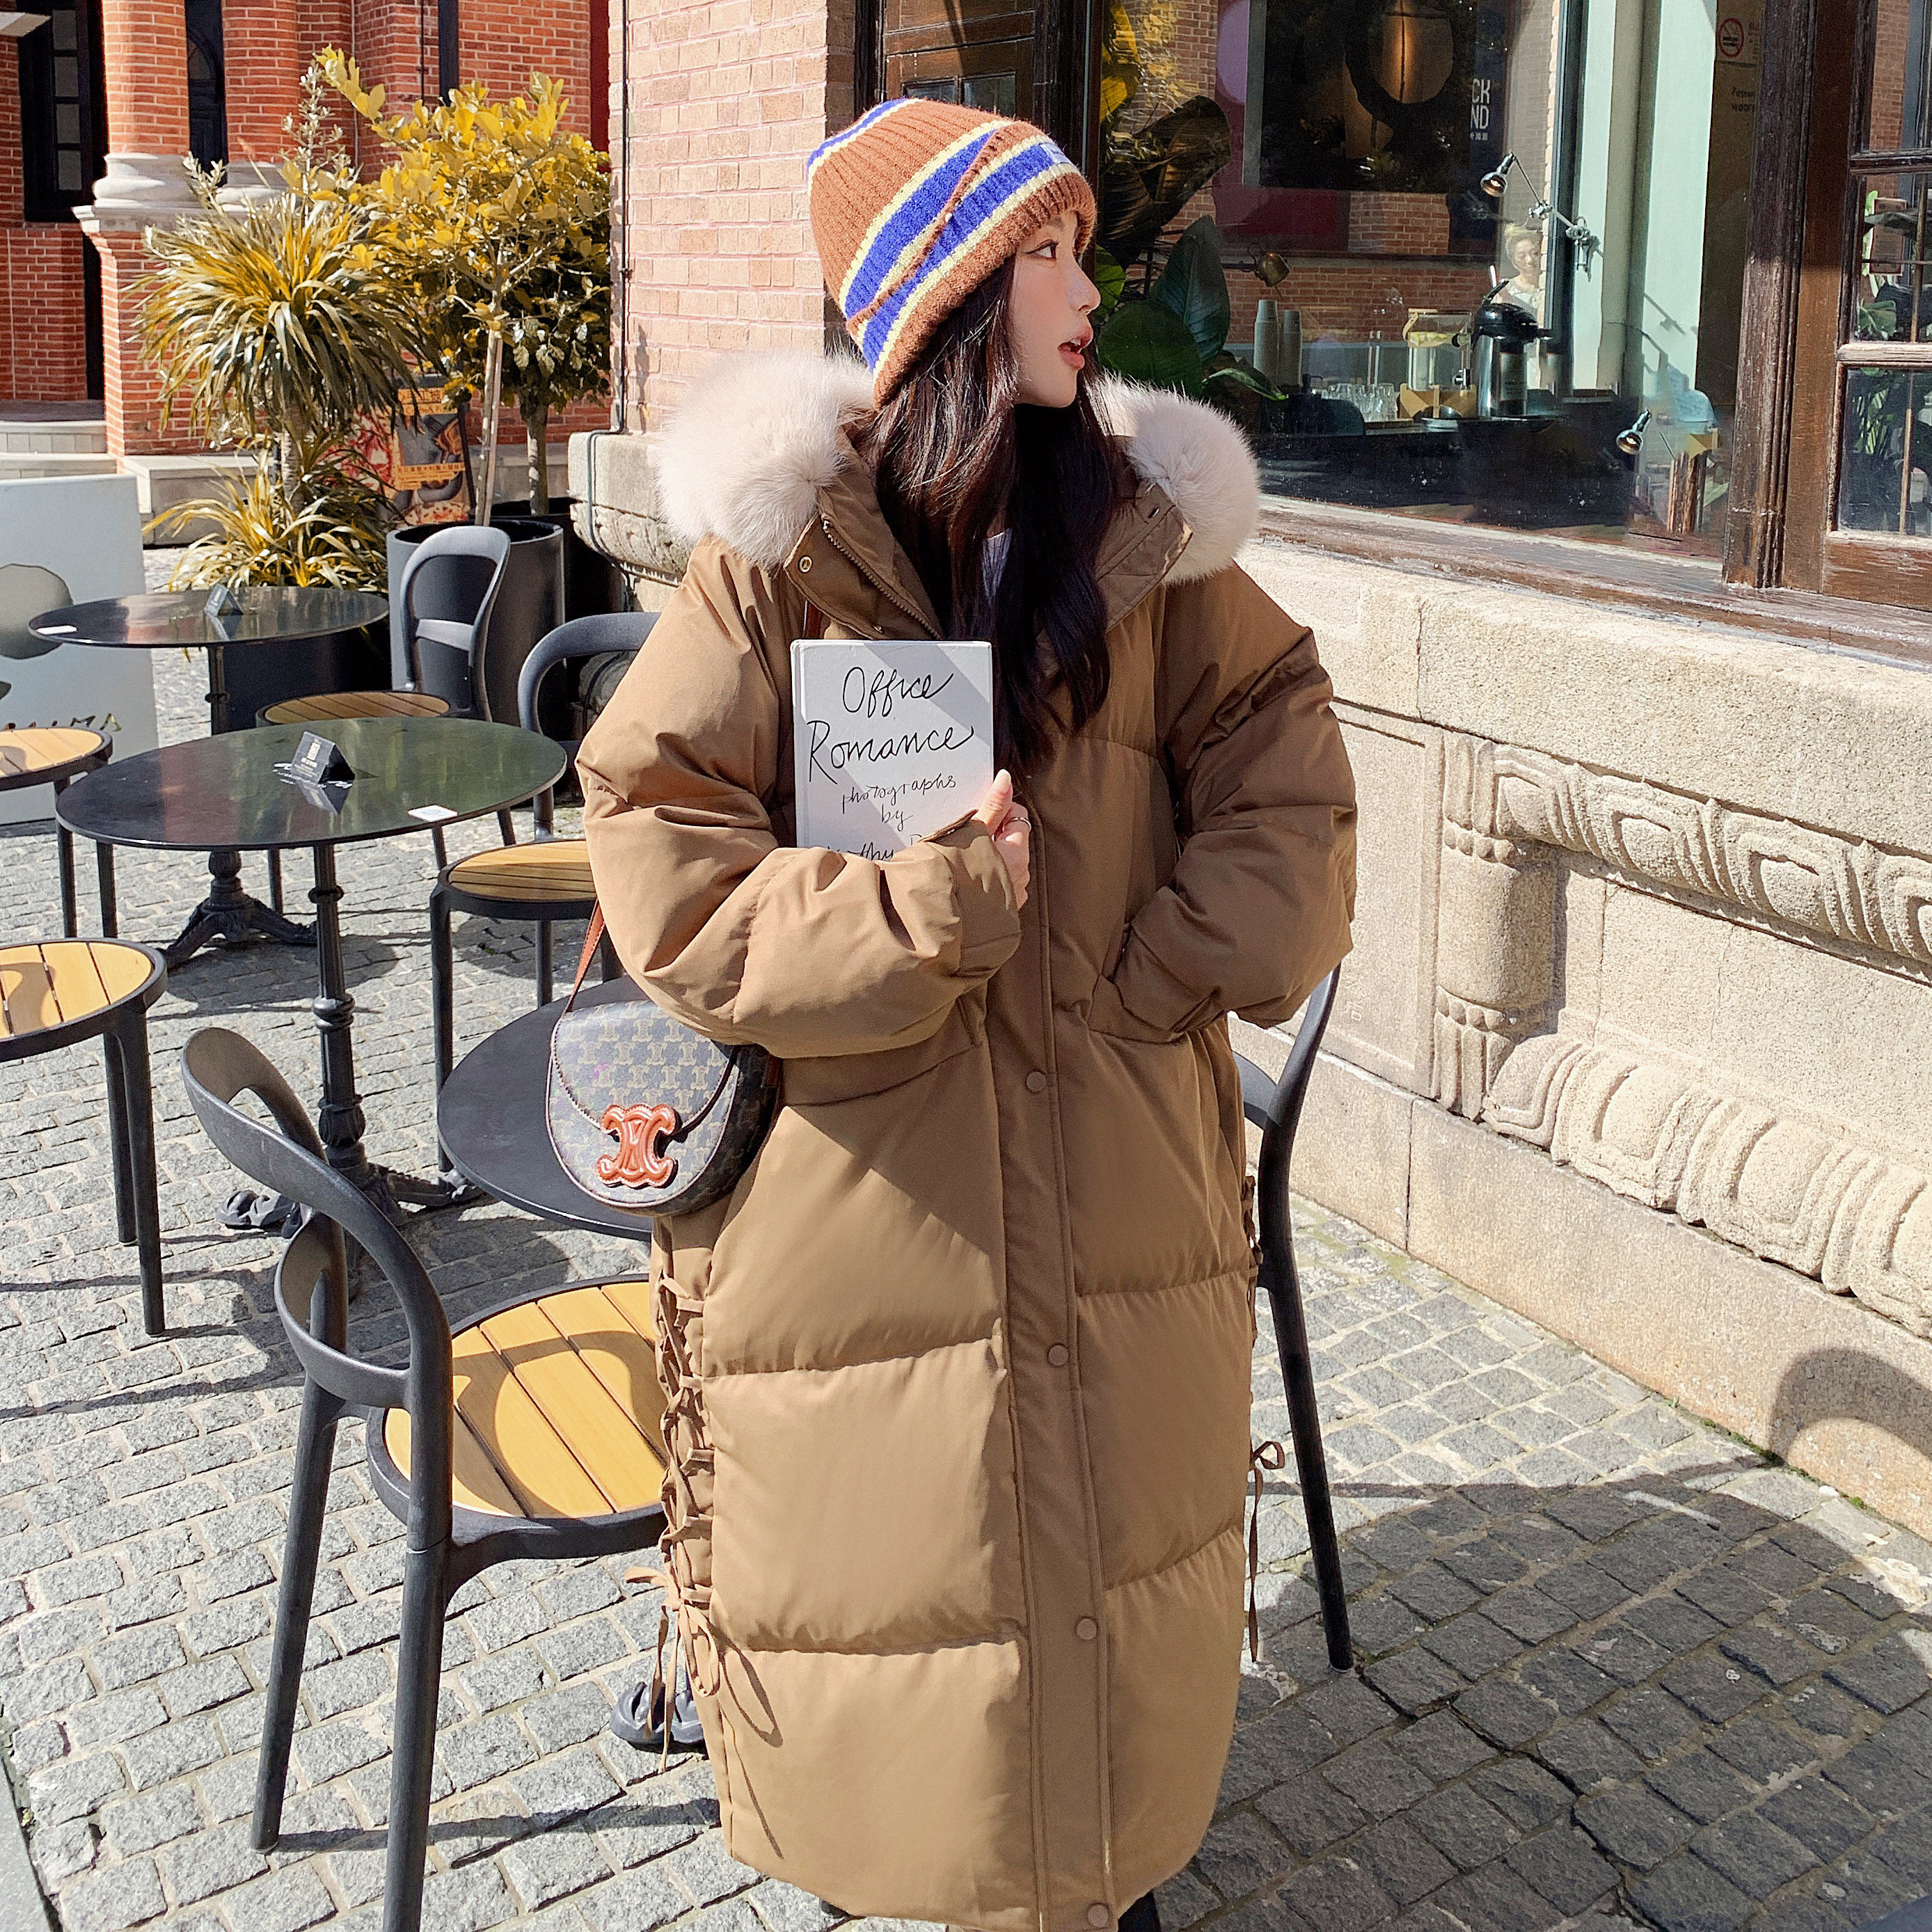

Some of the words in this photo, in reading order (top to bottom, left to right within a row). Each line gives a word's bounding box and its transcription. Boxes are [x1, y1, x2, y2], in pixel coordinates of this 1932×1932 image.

[843, 666, 954, 718] Office
[806, 720, 974, 784] Romance
[841, 773, 956, 814] photographs
[881, 804, 914, 832] by
